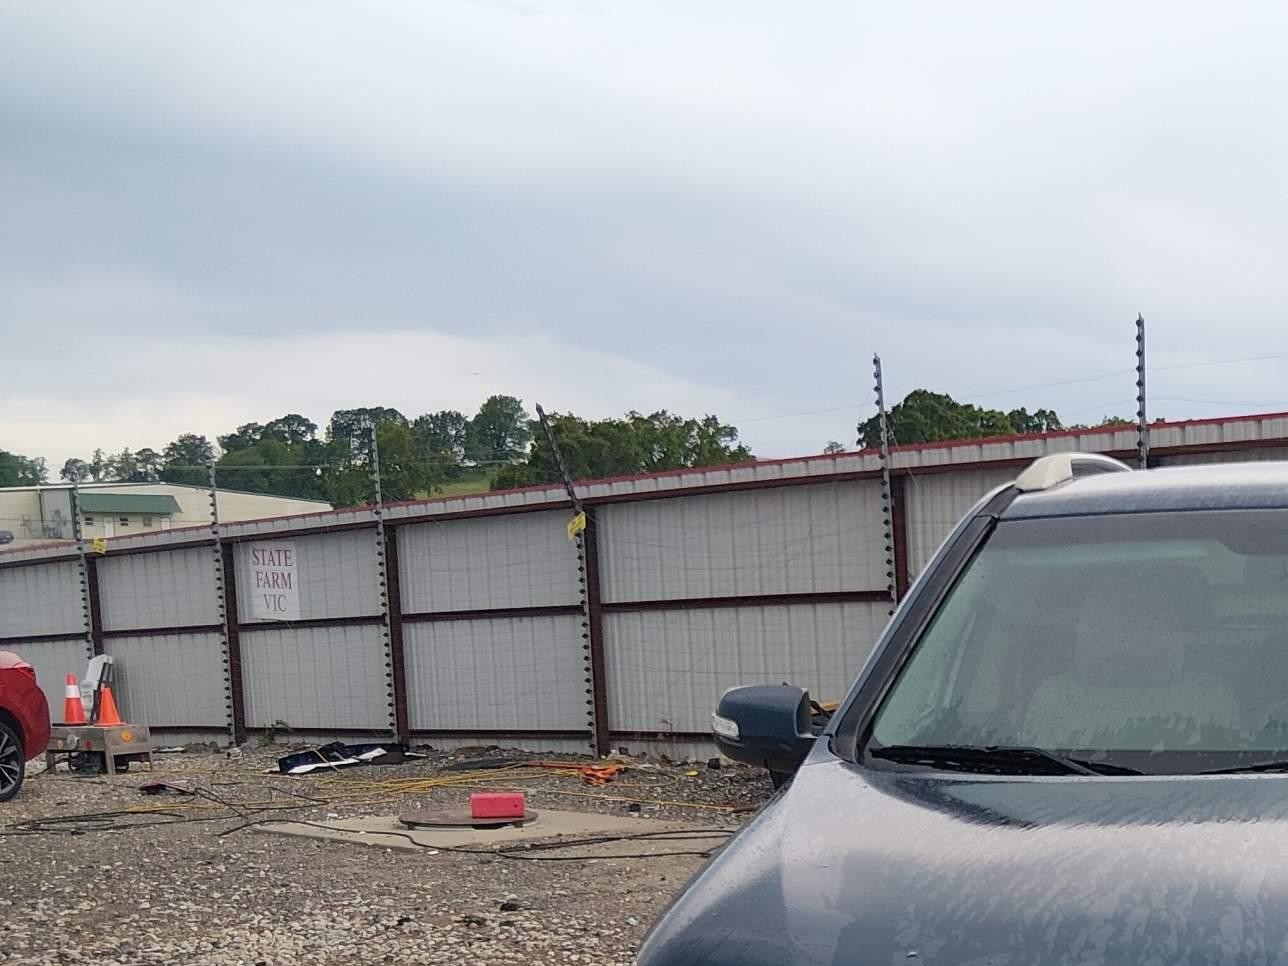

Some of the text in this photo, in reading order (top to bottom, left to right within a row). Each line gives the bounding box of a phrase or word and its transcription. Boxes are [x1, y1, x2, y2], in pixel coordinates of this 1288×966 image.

[252, 548, 293, 567] STATE
[256, 571, 292, 590] FARM
[263, 594, 287, 612] VIC
